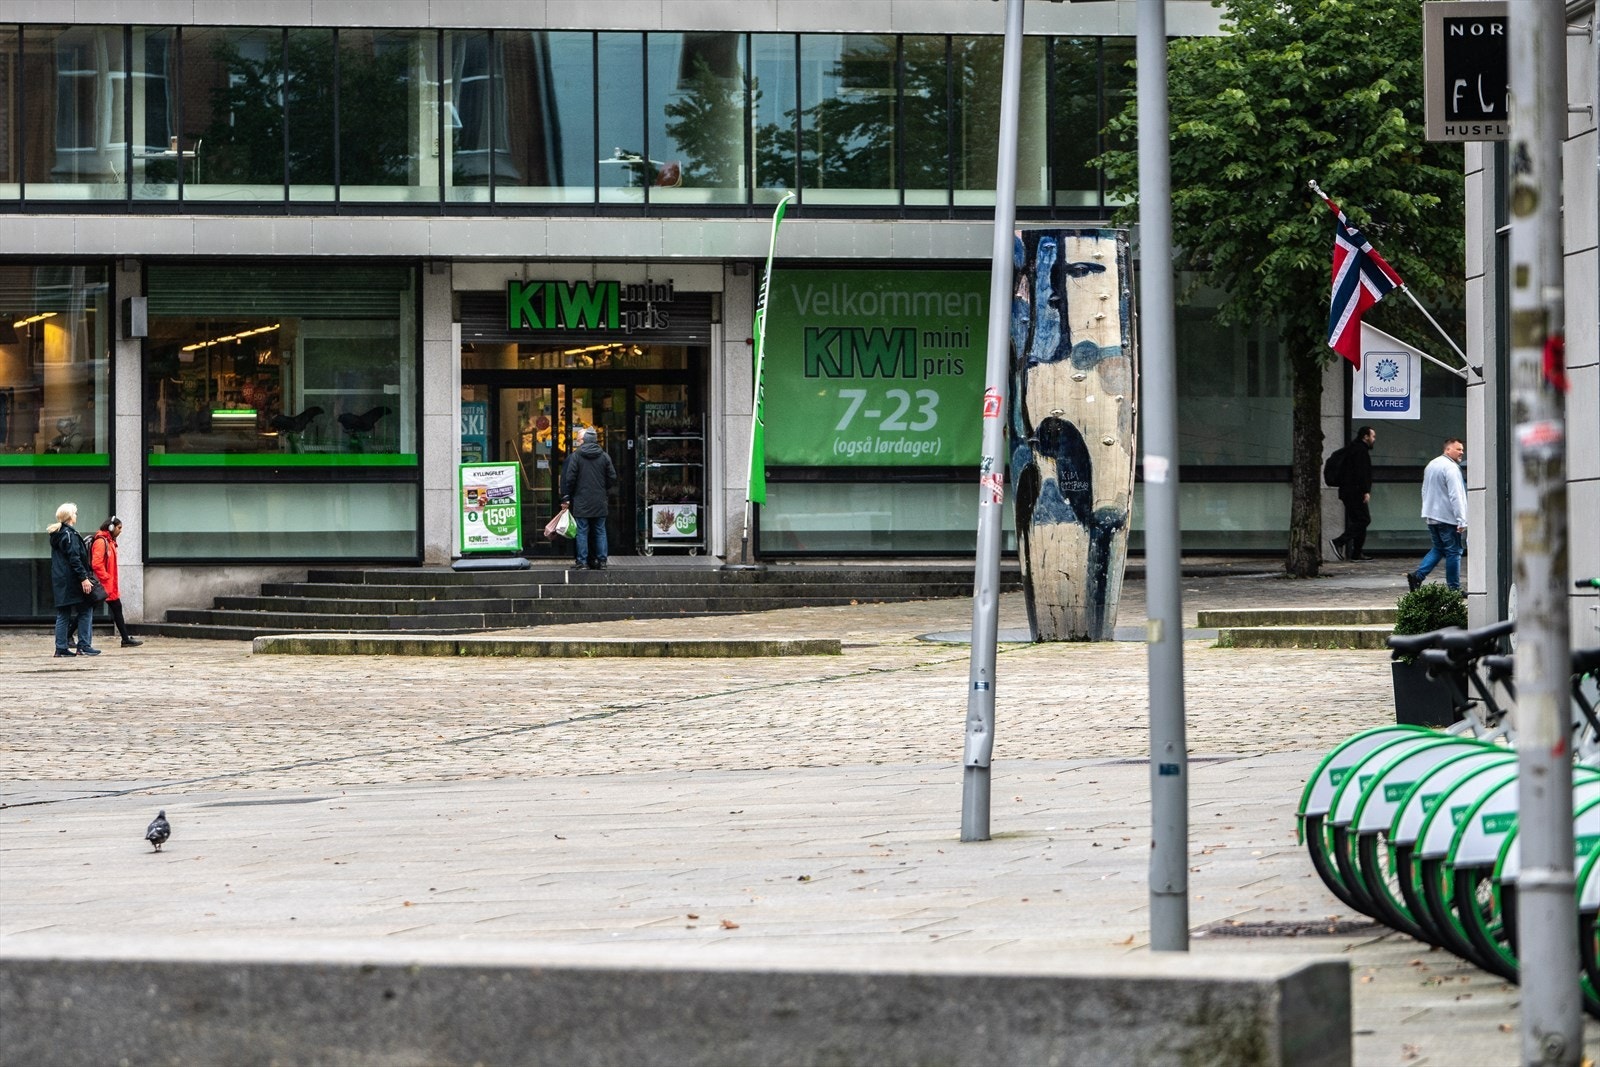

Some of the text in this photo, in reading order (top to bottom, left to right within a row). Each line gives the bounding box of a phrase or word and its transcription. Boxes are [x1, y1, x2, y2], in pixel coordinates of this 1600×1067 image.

[1450, 23, 1504, 36] NOR
[507, 279, 674, 331] KIWI mini
[791, 283, 982, 316] Velkommen
[625, 305, 670, 334] pris
[804, 326, 970, 379] KIWI mini
[923, 353, 964, 380] pris
[835, 388, 940, 431] 7-23
[1370, 400, 1404, 408] TAX FREE
[833, 436, 941, 457] (også lørdager)
